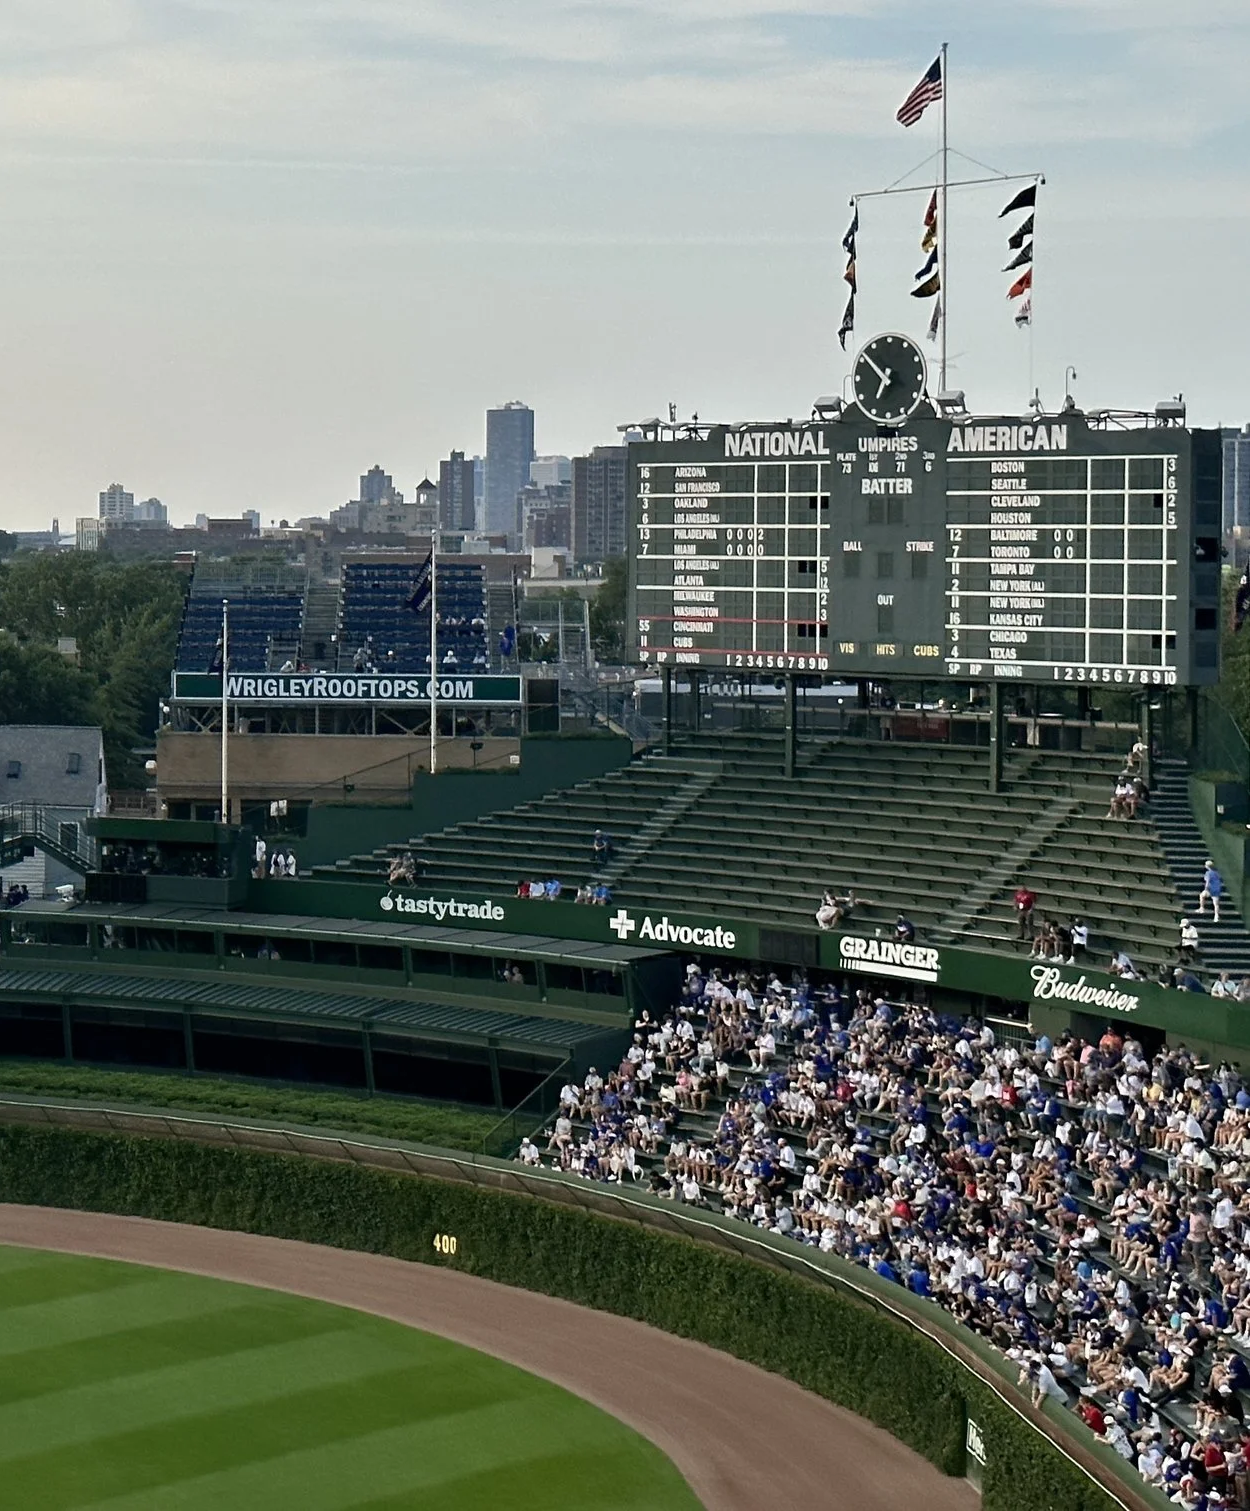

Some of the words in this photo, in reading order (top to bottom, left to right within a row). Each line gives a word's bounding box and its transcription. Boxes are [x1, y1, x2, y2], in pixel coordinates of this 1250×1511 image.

[725, 431, 829, 456] NATIONAL
[859, 436, 918, 452] UMPIRES
[947, 425, 1067, 452] AMERICAN
[675, 467, 706, 477] ARIZONA
[992, 462, 1024, 473] BOSTON
[688, 482, 720, 492] FRANCISCO
[862, 479, 912, 494] BATTER
[992, 479, 1026, 489] SEATTLE
[675, 498, 708, 508] OAKLAND
[992, 496, 1040, 507] CLEVELAND
[991, 513, 1031, 523] HOUSTON
[674, 529, 717, 539] PHILADELPHIA
[991, 530, 1037, 541] BALTIMORE
[674, 545, 695, 554] MIAMI
[991, 546, 1030, 557] TORONTO
[991, 564, 1017, 575] TAMPA
[1019, 564, 1035, 575] BAY
[674, 576, 703, 586] ATLANTA
[990, 580, 1008, 591] NEW
[674, 591, 714, 601] MILWAUKEE
[878, 595, 893, 605] OUT
[990, 597, 1007, 608] NEW
[674, 607, 718, 617] WASHINGTON
[990, 614, 1022, 625] KANSAS
[1024, 615, 1043, 626] CITY
[674, 637, 693, 647] CUBS
[990, 631, 1027, 642] CHICAGO
[840, 643, 854, 653] VIS
[877, 645, 895, 655] HITS
[914, 645, 939, 656] CUBS
[990, 648, 1016, 659] TEXAS
[226, 676, 473, 699] WRIGLEYROOFTOPS.COM
[396, 898, 504, 920] tastytrade
[639, 916, 735, 949] Advocate
[840, 936, 939, 970] GRAINGER
[1030, 965, 1139, 1012] Budweiser
[433, 1234, 456, 1254] 400
